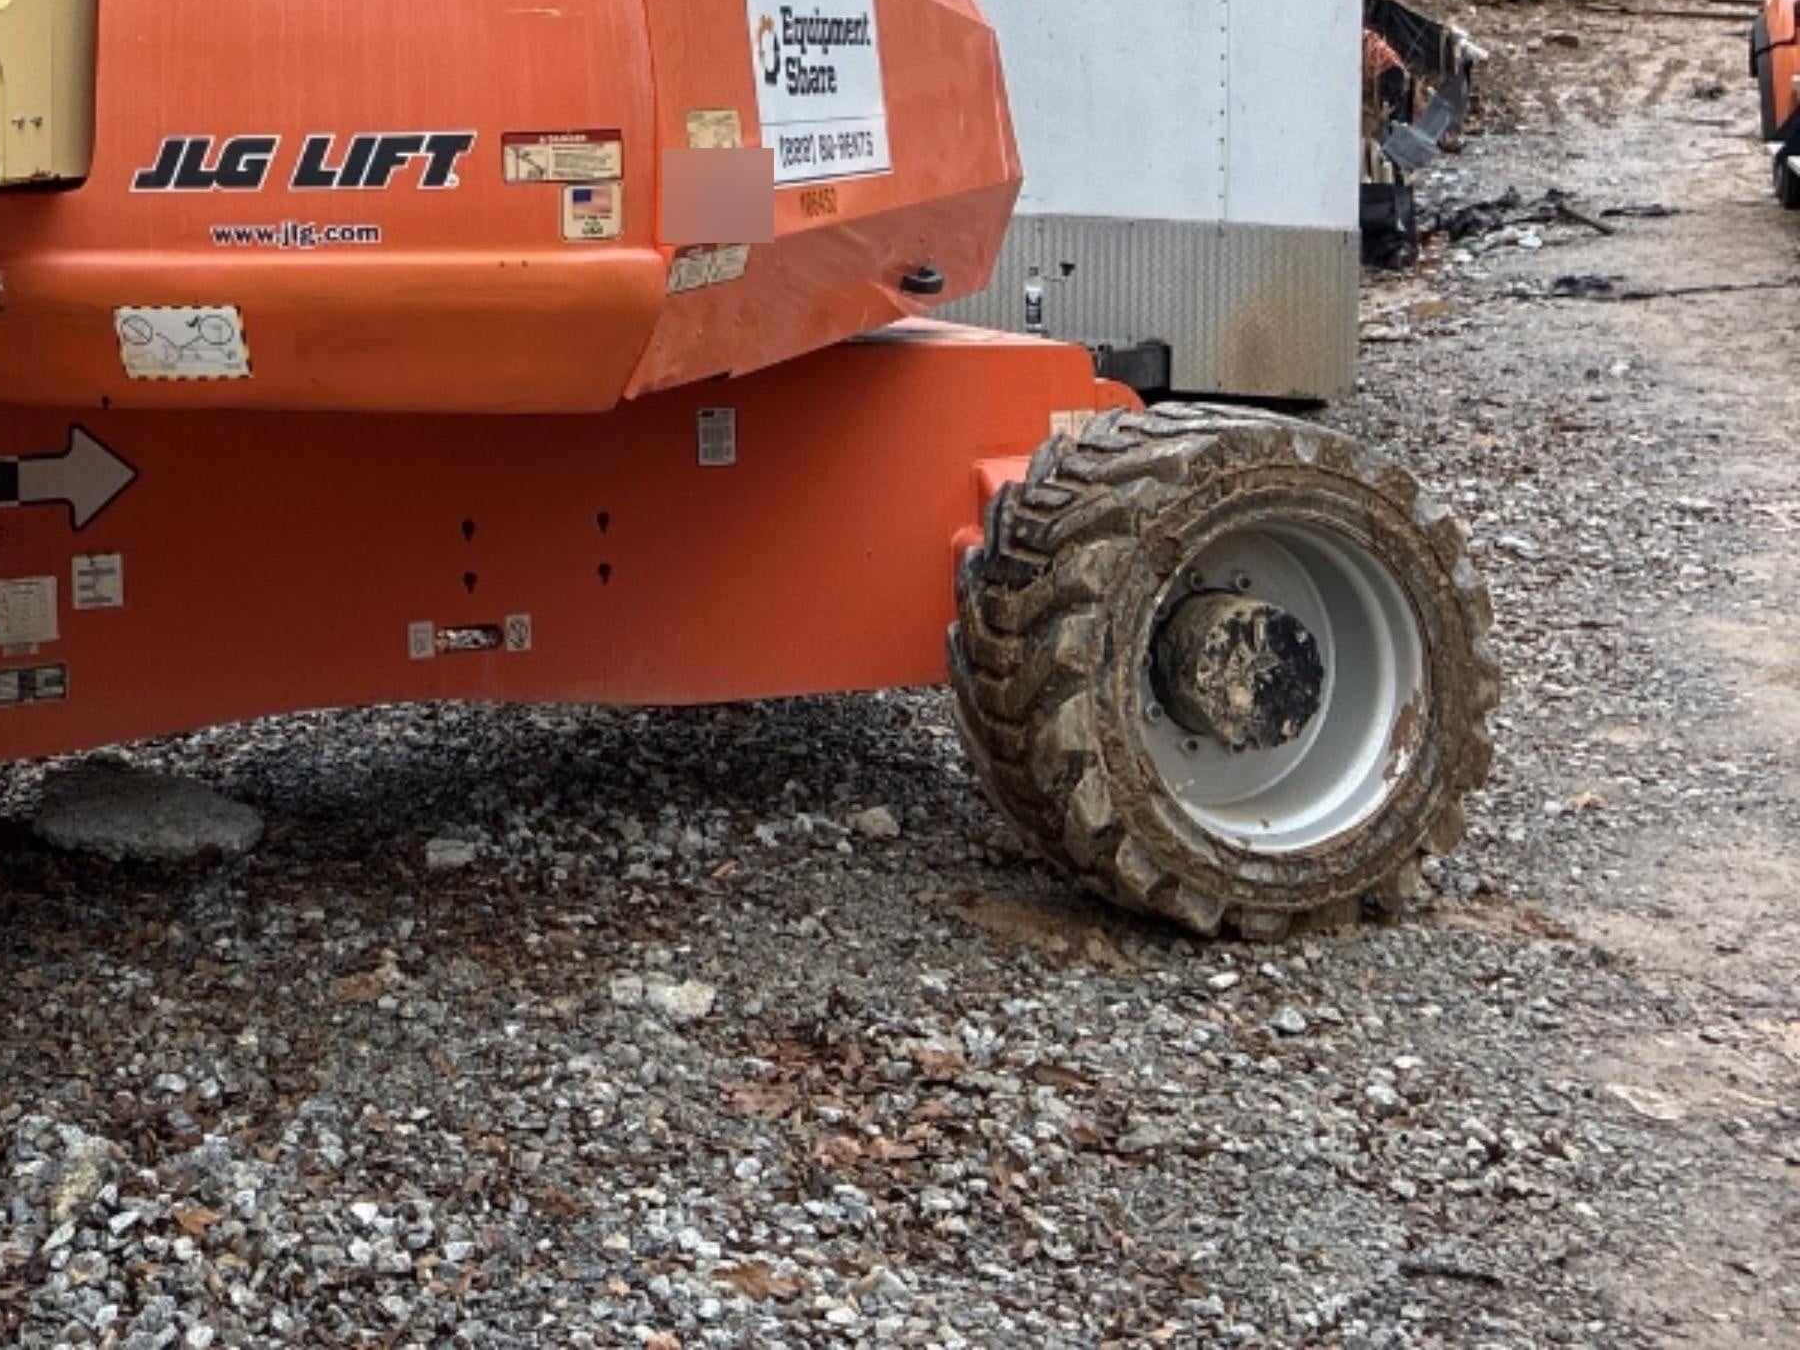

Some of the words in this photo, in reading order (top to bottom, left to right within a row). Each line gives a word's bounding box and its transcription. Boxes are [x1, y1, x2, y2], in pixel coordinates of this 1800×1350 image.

[779, 5, 872, 55] Equipment
[784, 56, 837, 96] Share
[130, 133, 282, 192] JLG
[288, 130, 478, 191] LIFT
[210, 220, 382, 248] www.jlg.com
